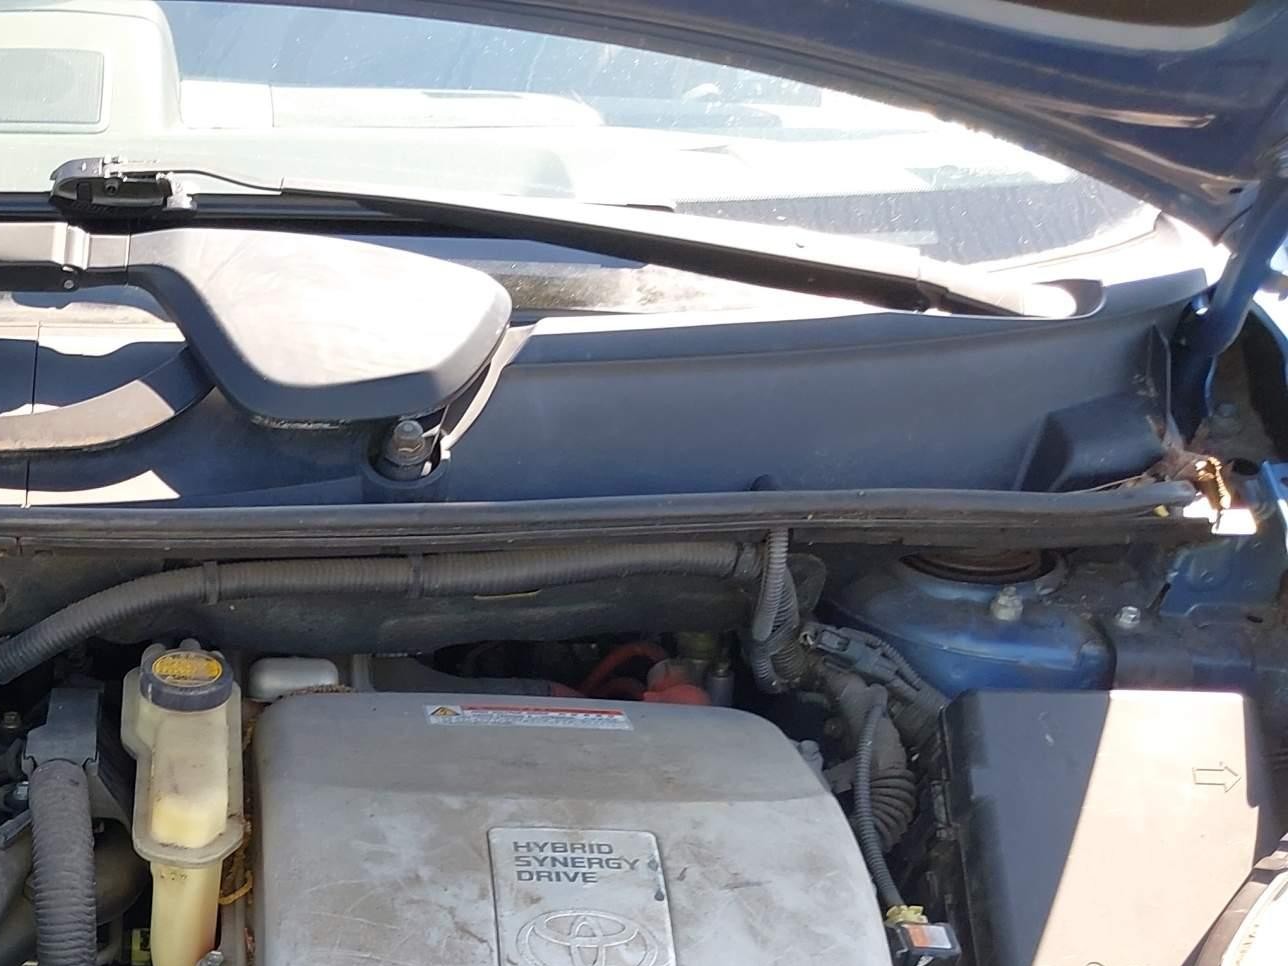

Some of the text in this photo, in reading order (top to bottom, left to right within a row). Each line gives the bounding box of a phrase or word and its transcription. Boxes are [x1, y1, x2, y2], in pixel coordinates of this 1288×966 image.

[513, 841, 614, 854] HYBRID
[514, 855, 640, 871] SYNERGY
[517, 870, 598, 883] DRIVE
